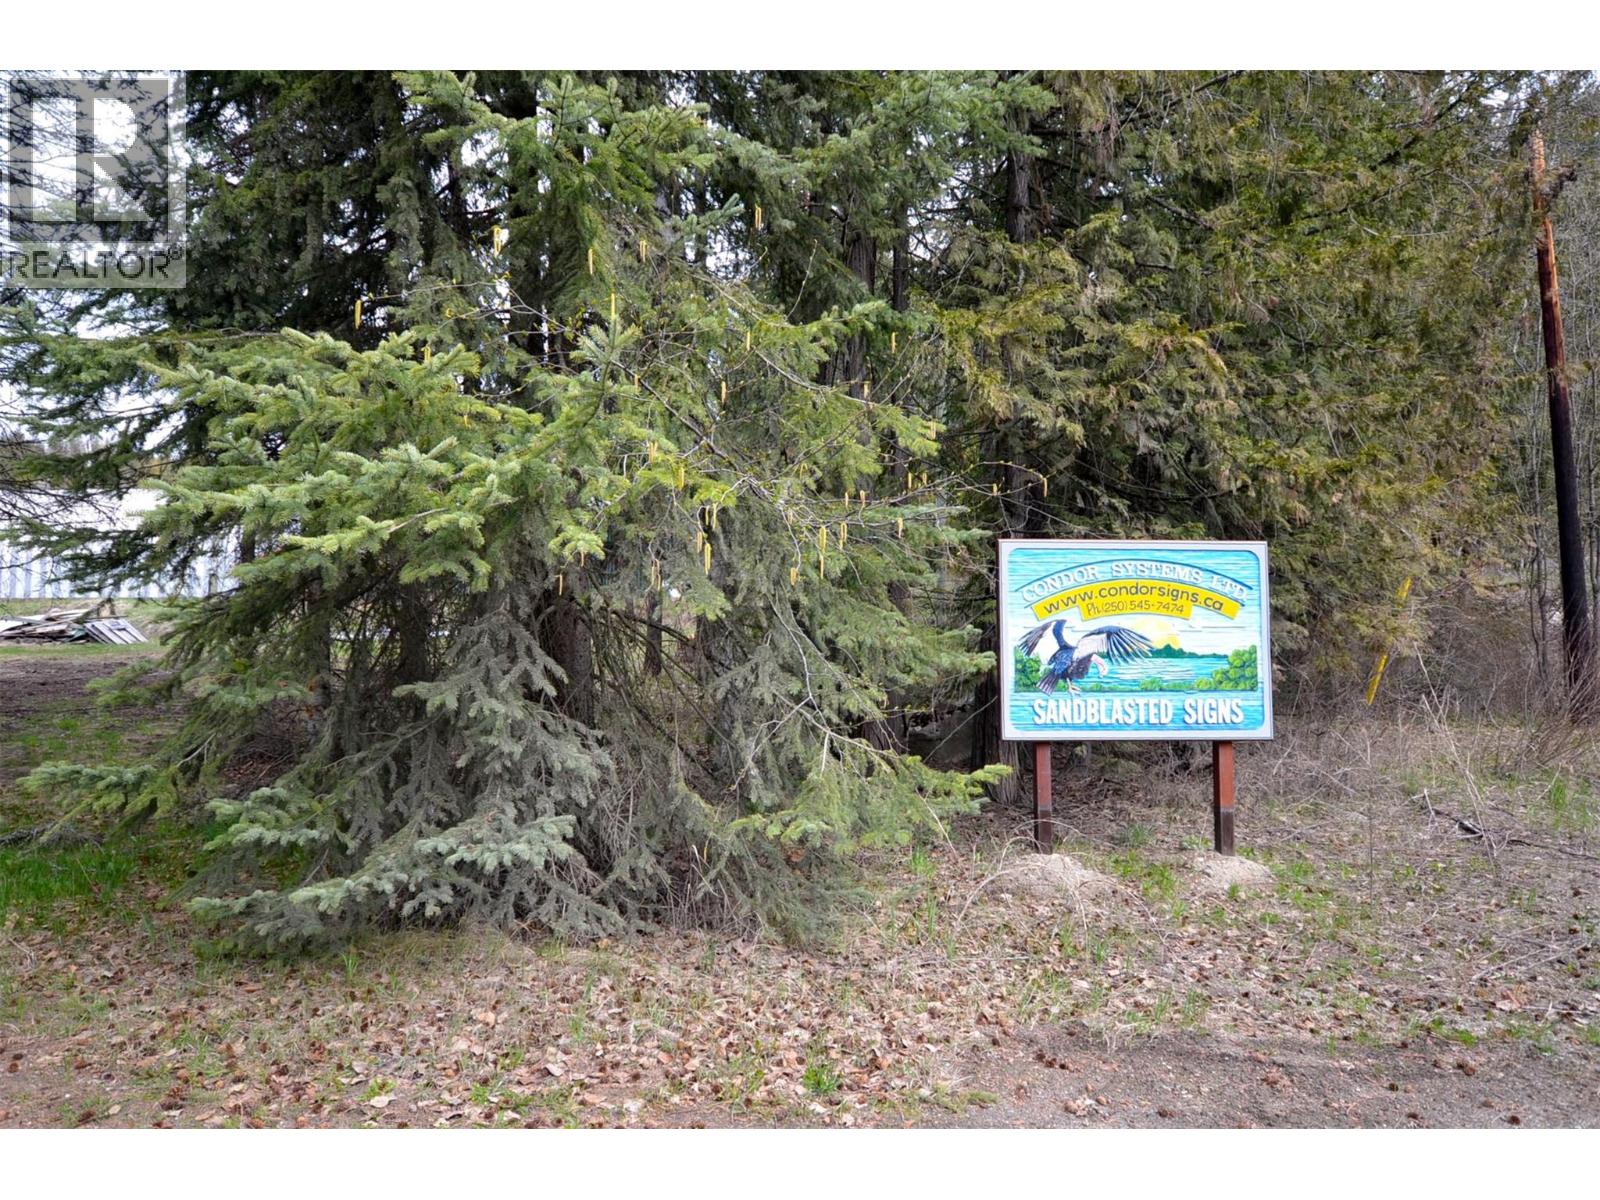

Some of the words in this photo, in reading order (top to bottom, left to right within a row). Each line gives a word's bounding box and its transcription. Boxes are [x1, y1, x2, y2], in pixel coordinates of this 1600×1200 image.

[1022, 565, 1099, 602] CONDOR
[1111, 561, 1203, 584] SYSTEMS
[1043, 582, 1224, 615] www.condorsigns.ca
[1032, 700, 1173, 725] SANDBLASTED
[1183, 699, 1245, 725] SIGNS
